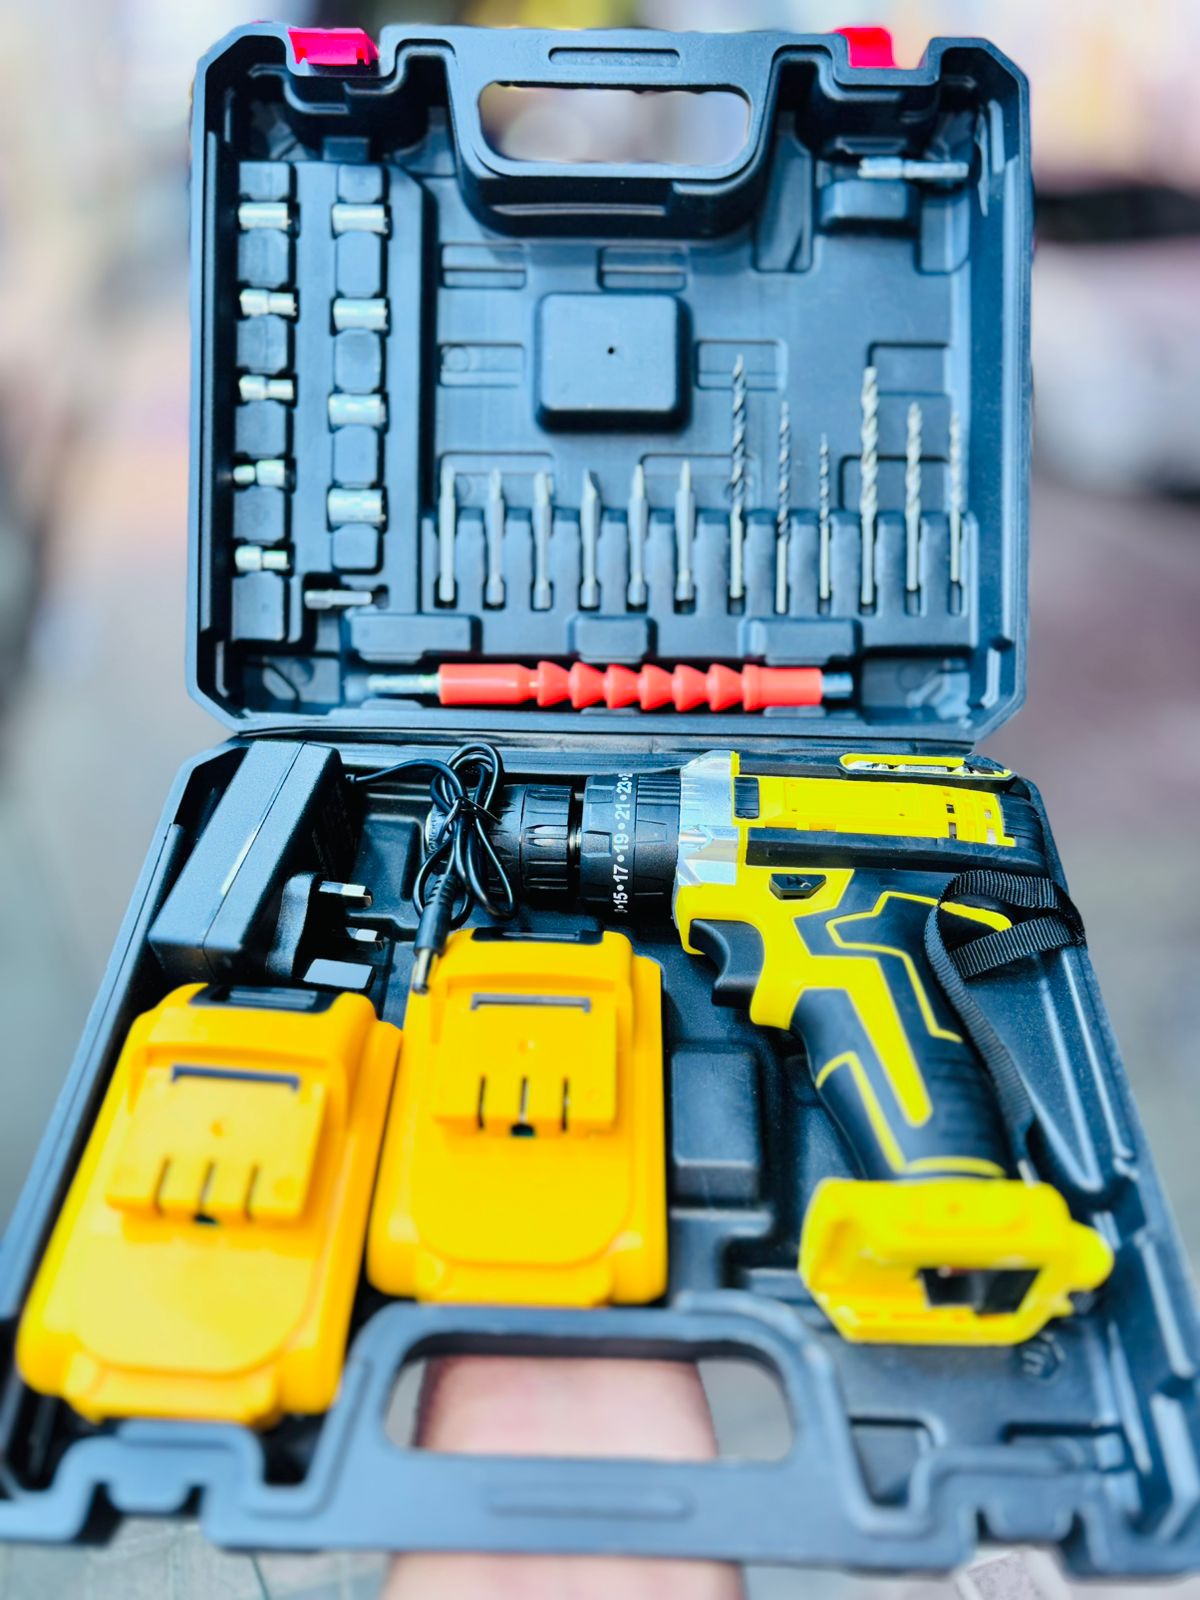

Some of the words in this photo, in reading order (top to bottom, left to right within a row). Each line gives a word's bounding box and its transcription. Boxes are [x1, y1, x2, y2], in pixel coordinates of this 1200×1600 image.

[616, 781, 632, 794] 23
[615, 804, 630, 820] 21
[613, 833, 629, 853] 19
[613, 864, 629, 882] 17
[613, 892, 628, 904] 15
